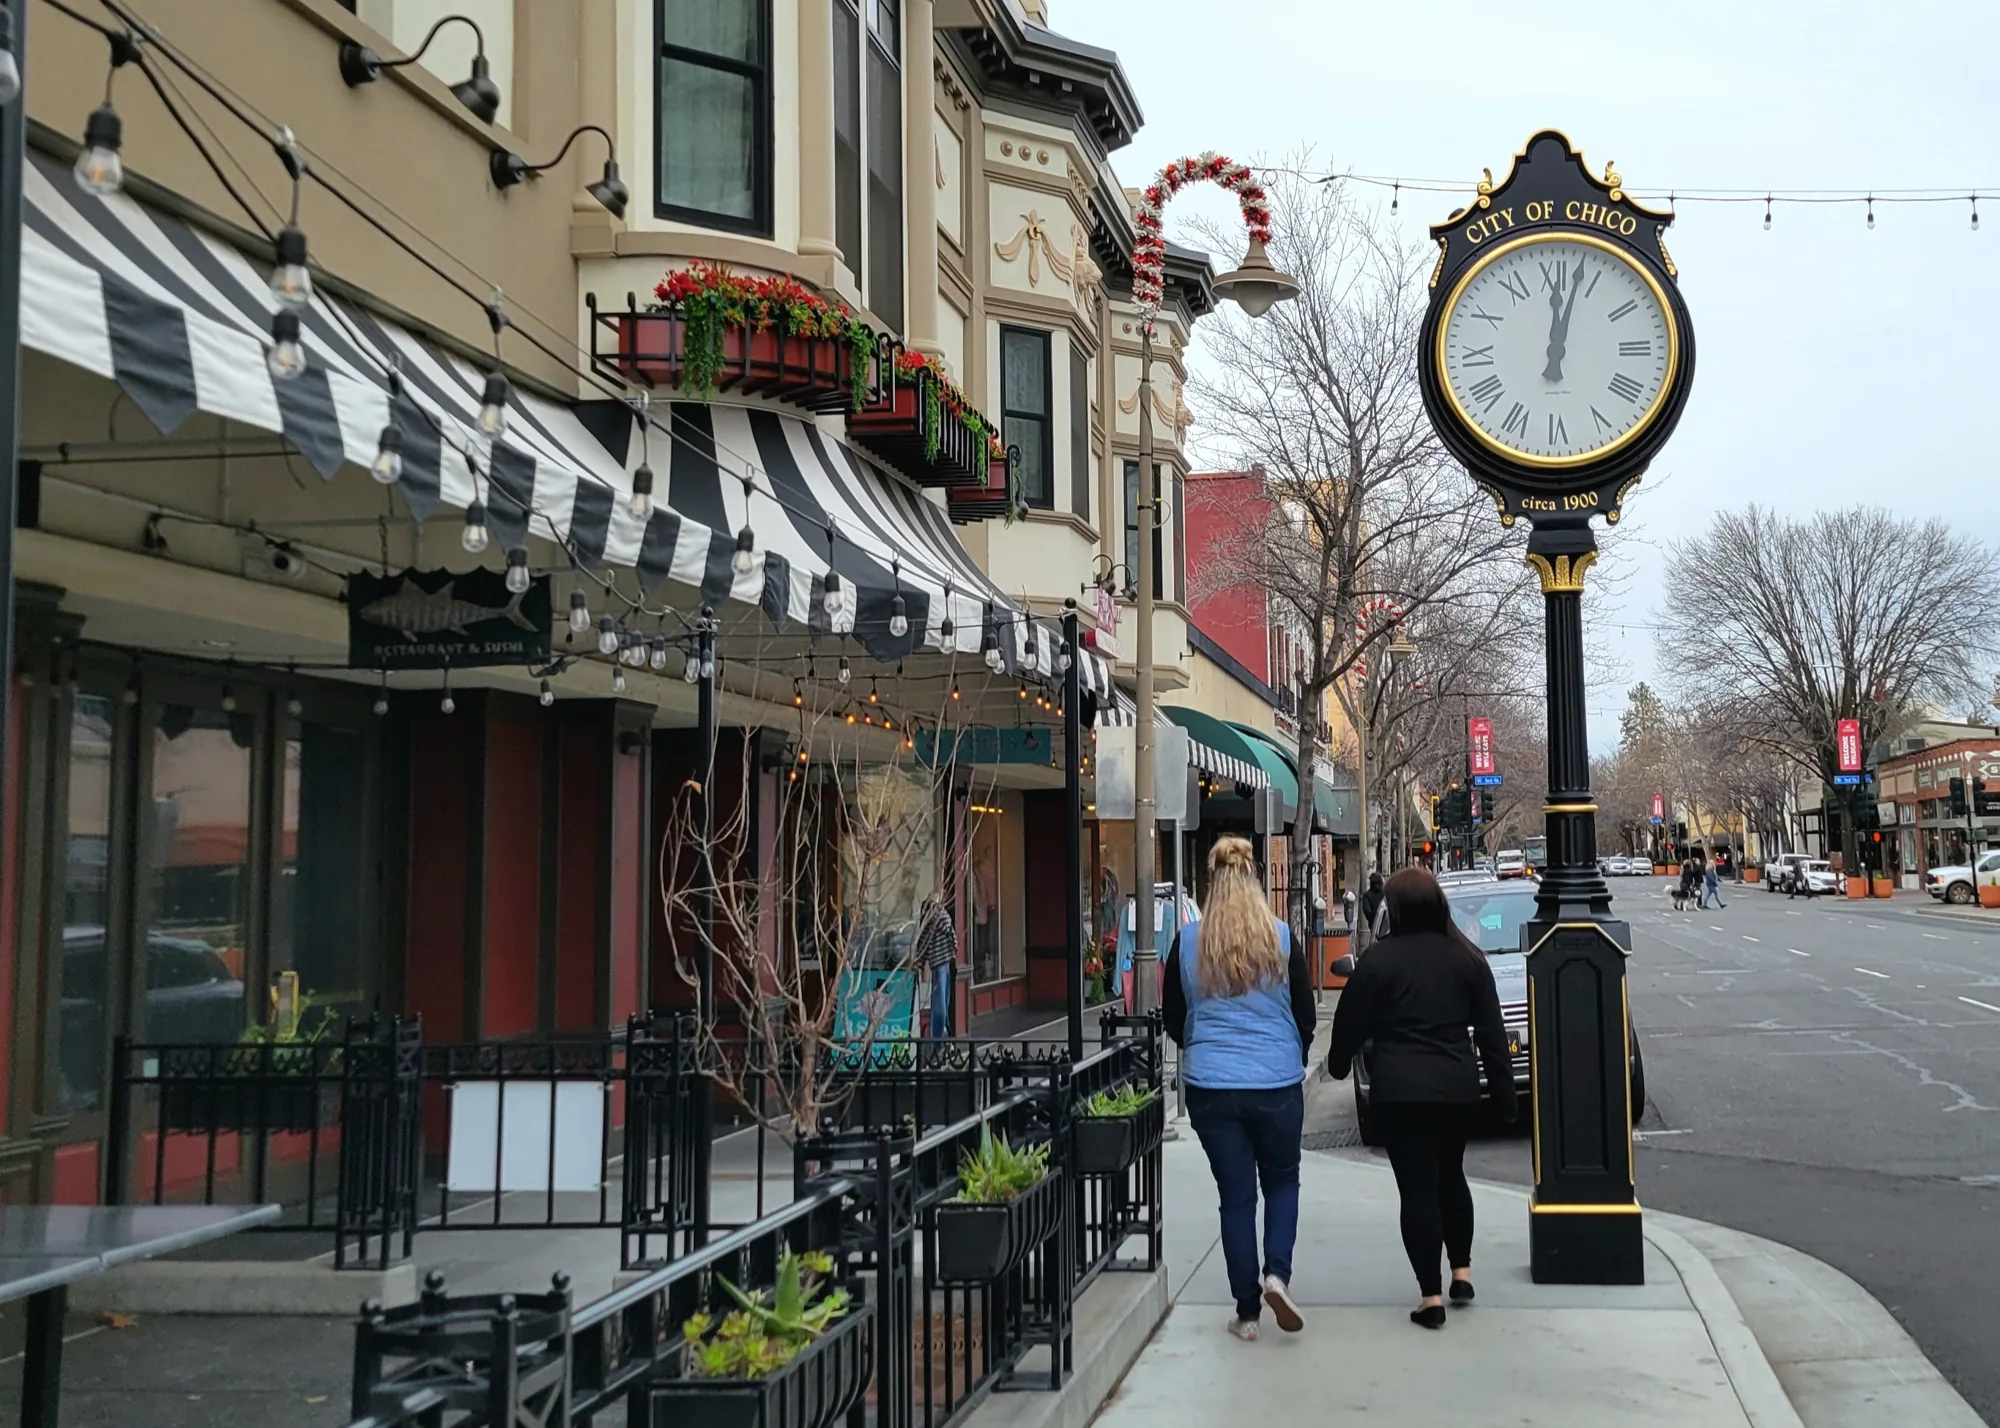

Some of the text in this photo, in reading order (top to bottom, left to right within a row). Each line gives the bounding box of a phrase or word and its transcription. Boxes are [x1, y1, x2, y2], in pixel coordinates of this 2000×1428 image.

[1466, 200, 1637, 244] CITY OF CHICO
[1521, 491, 1599, 511] circa 1900
[373, 641, 523, 657] RESTAURANT & SUSHI
